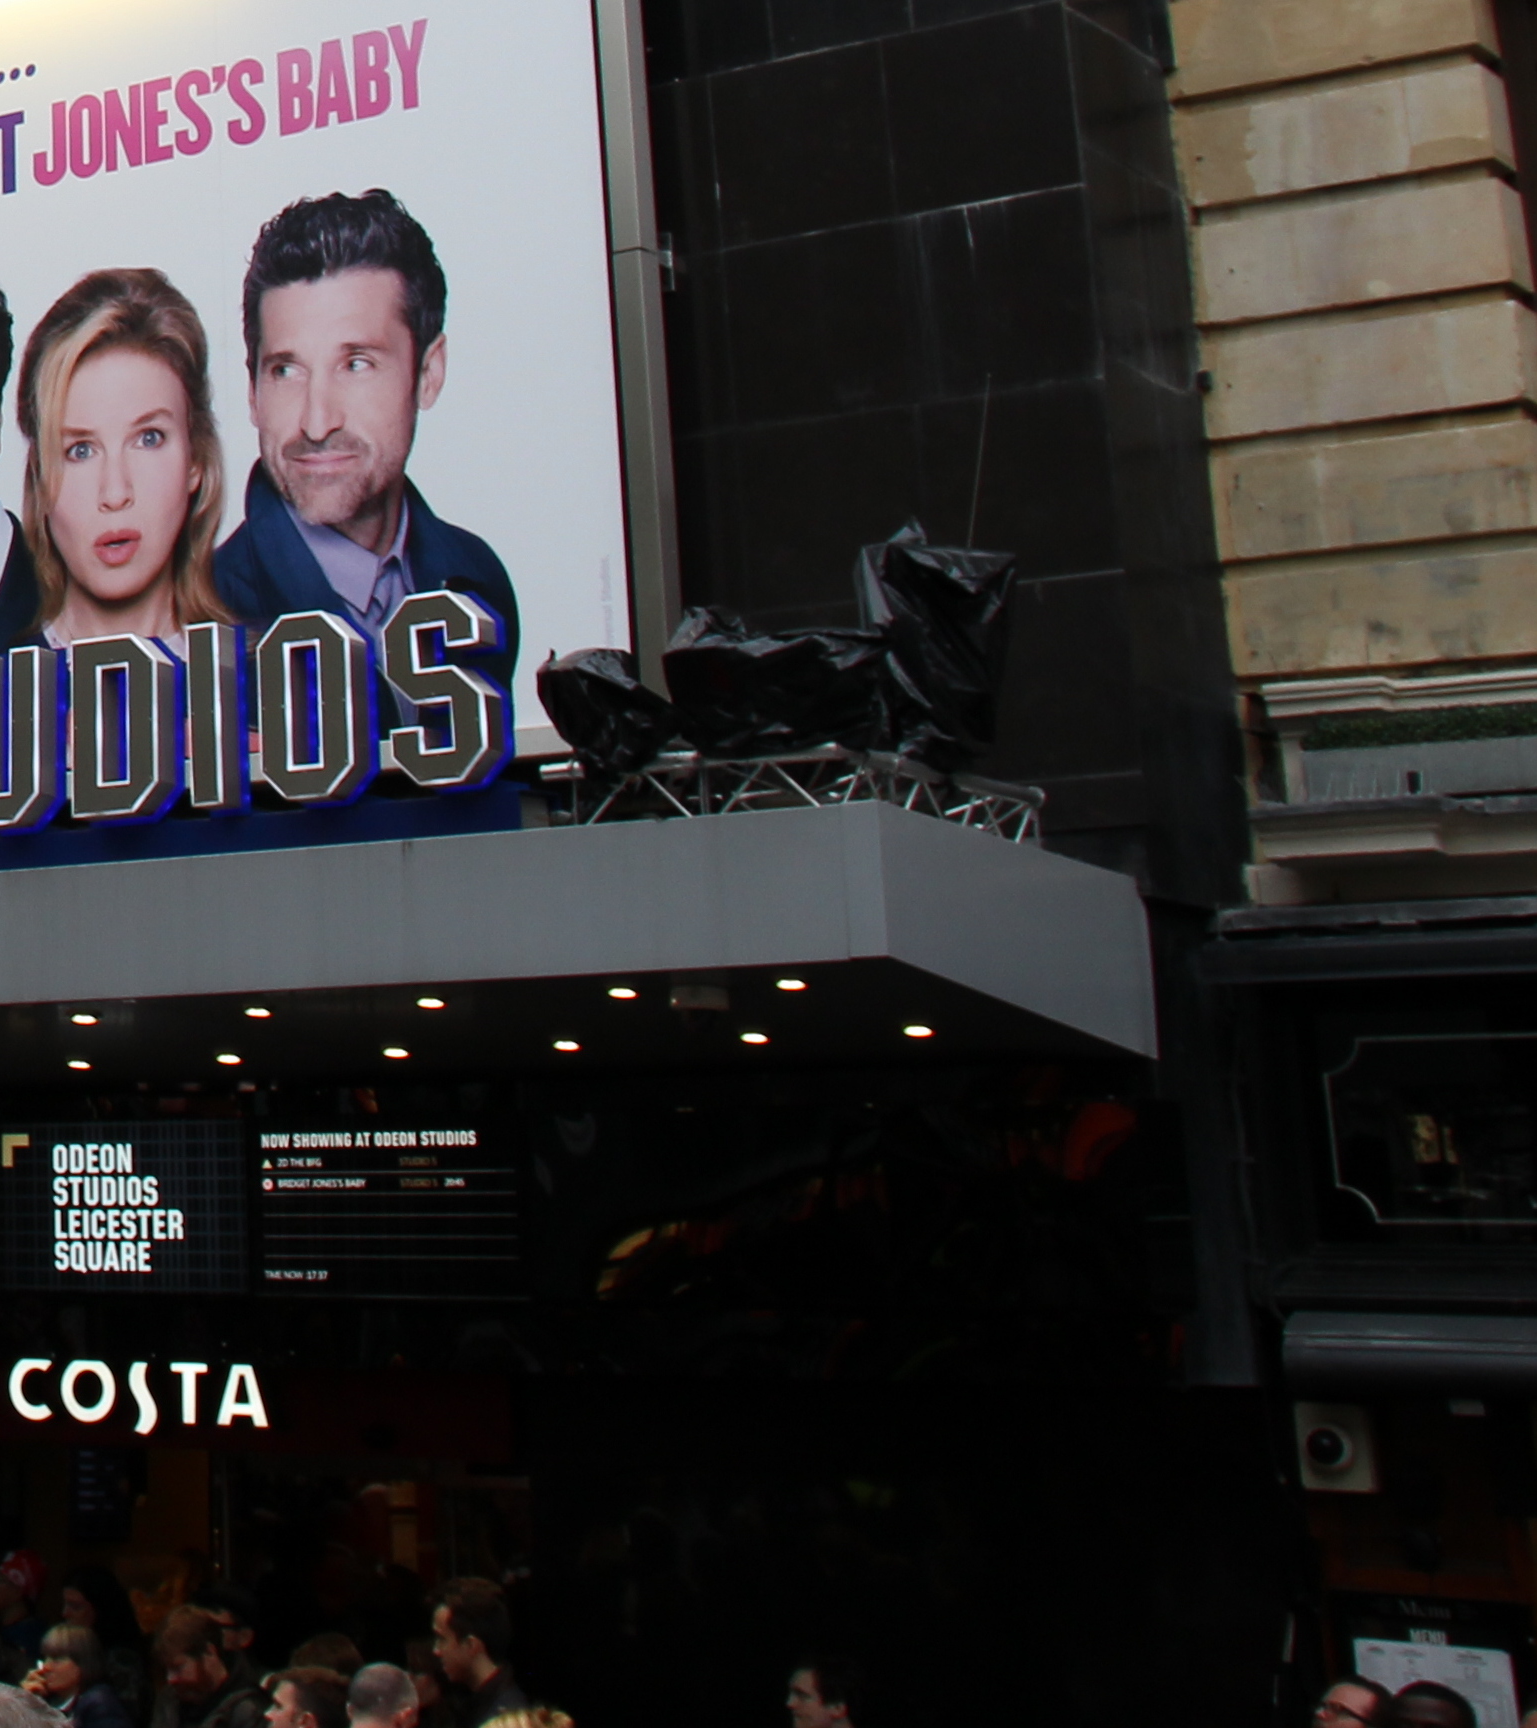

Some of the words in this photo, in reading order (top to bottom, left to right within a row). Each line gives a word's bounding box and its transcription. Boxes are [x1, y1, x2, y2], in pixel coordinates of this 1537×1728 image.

[276, 17, 429, 138] BABY
[260, 1132, 291, 1149] NOW
[291, 1131, 353, 1149] SHOWING
[354, 1131, 372, 1148] AT
[373, 1130, 418, 1148] ODEON
[419, 1129, 478, 1147] STUDIOS
[51, 1142, 134, 1174] ODEON
[51, 1175, 159, 1207] STUDIOS
[277, 1178, 311, 1189] BRIDGET
[53, 1208, 185, 1240] LEICESTER
[53, 1240, 153, 1274] SQUARE
[7, 1357, 271, 1437] COSTA
